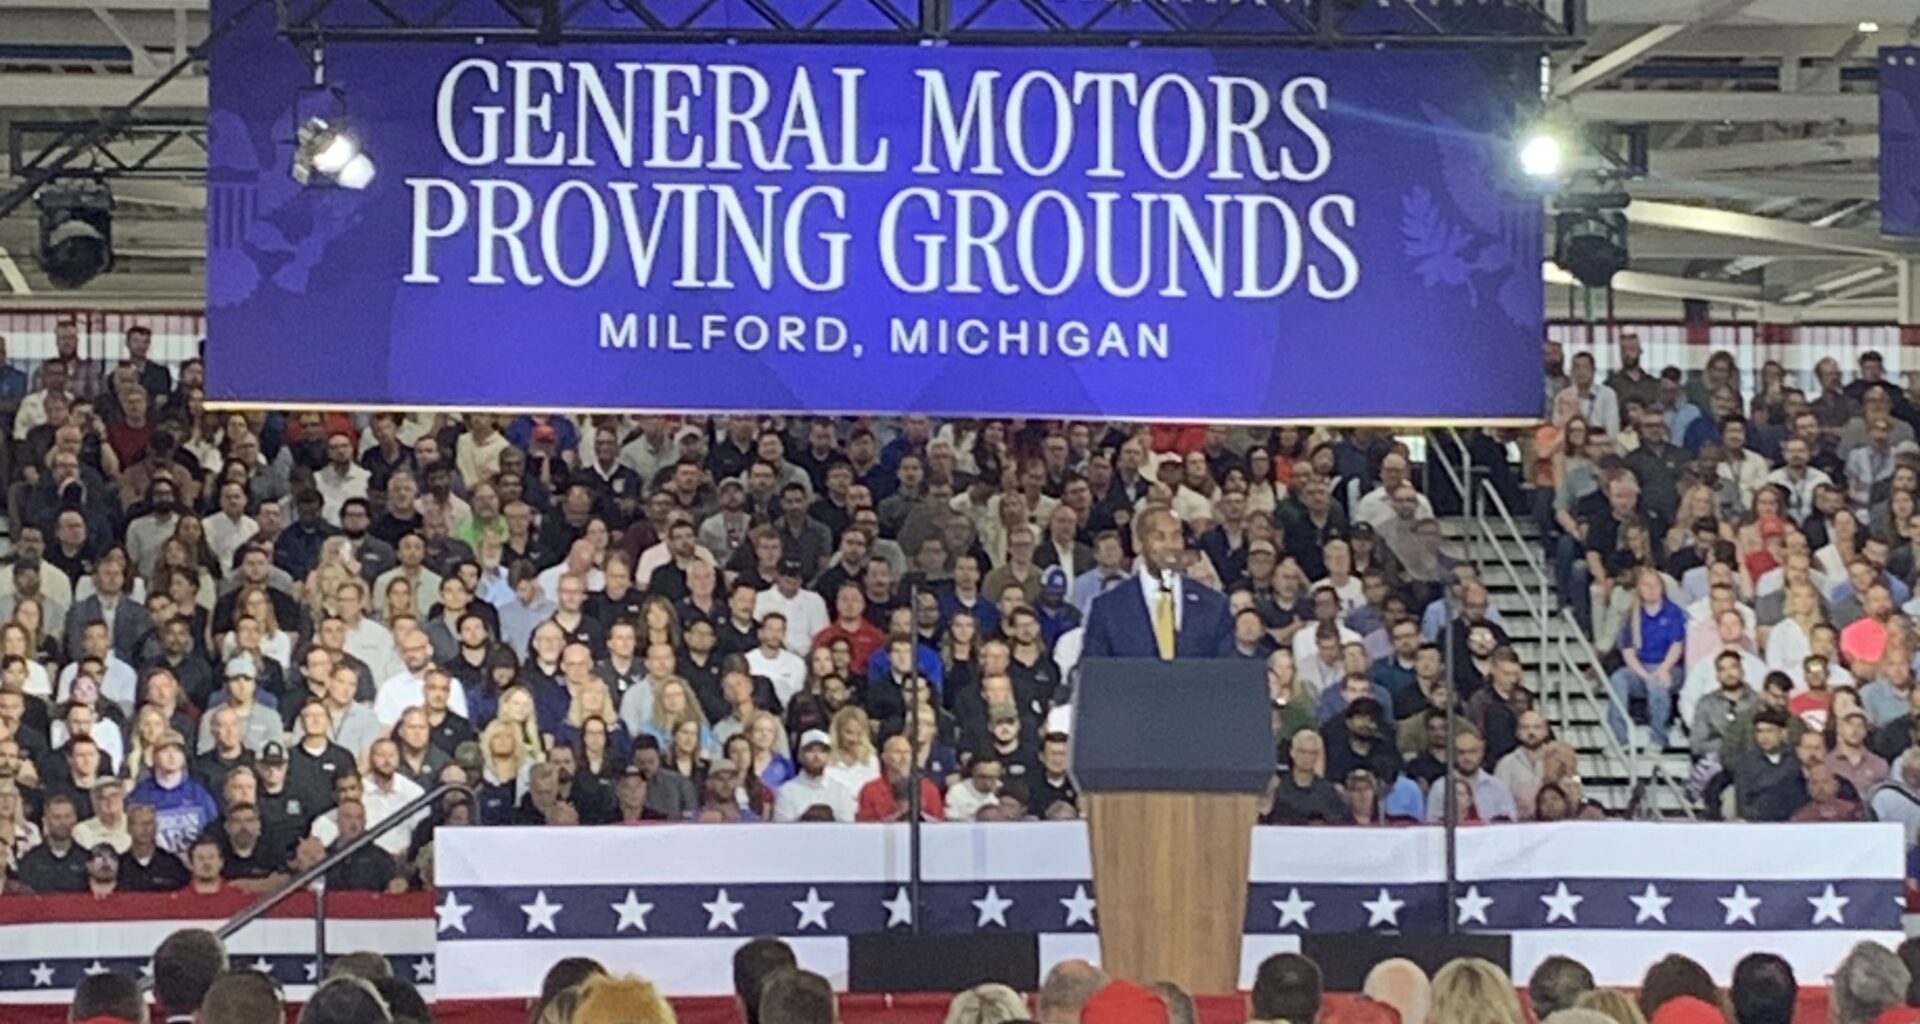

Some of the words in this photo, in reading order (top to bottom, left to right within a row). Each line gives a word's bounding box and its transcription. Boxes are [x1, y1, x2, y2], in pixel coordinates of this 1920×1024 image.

[437, 59, 888, 172] GENERAL
[912, 69, 1331, 181] MOTORS
[403, 178, 851, 291] PROVING
[879, 187, 1360, 299] GROUNDS
[600, 313, 863, 358] MILFORD,
[891, 318, 1169, 358] MICHIGAN
